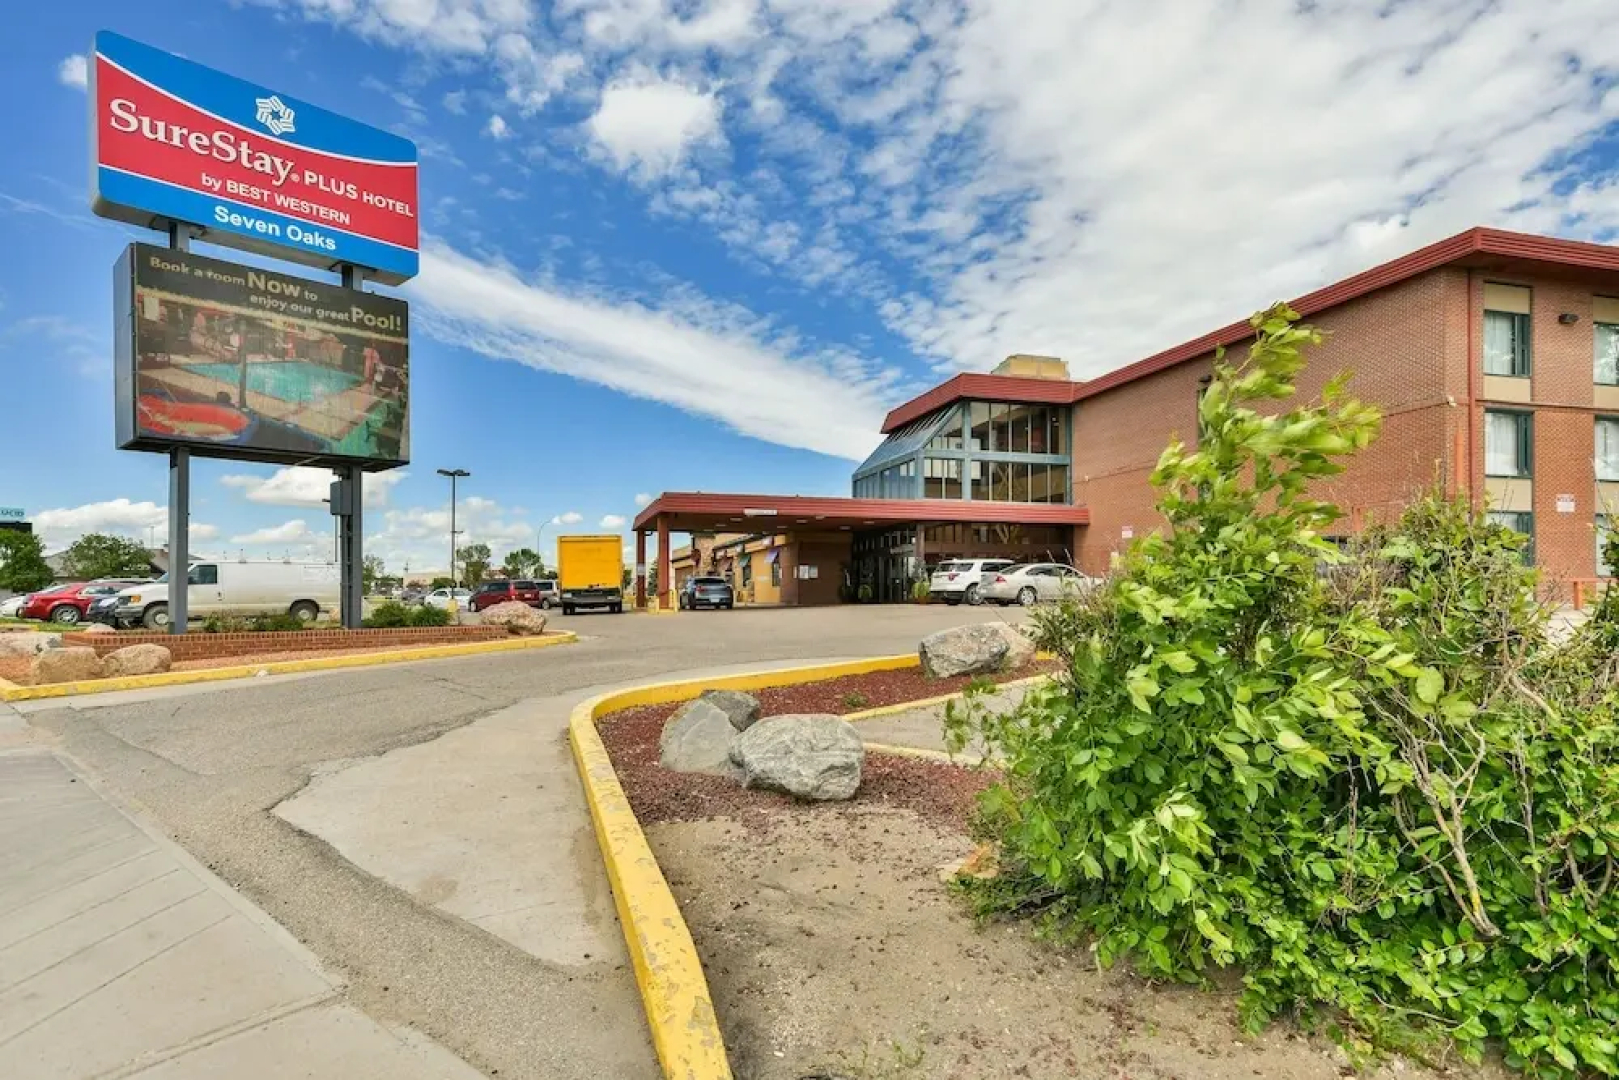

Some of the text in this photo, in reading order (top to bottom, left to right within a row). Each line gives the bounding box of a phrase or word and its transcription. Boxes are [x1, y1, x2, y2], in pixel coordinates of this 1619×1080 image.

[201, 173, 351, 226] by BEST WESTERN
[303, 170, 358, 200] PLUS
[362, 191, 414, 217] HOTEL
[214, 204, 336, 251] Seven Oaks
[149, 256, 189, 275] Book
[194, 268, 203, 278] a
[207, 271, 245, 286] room
[304, 289, 318, 302] to
[250, 294, 401, 331] enjoy our great Pool!
